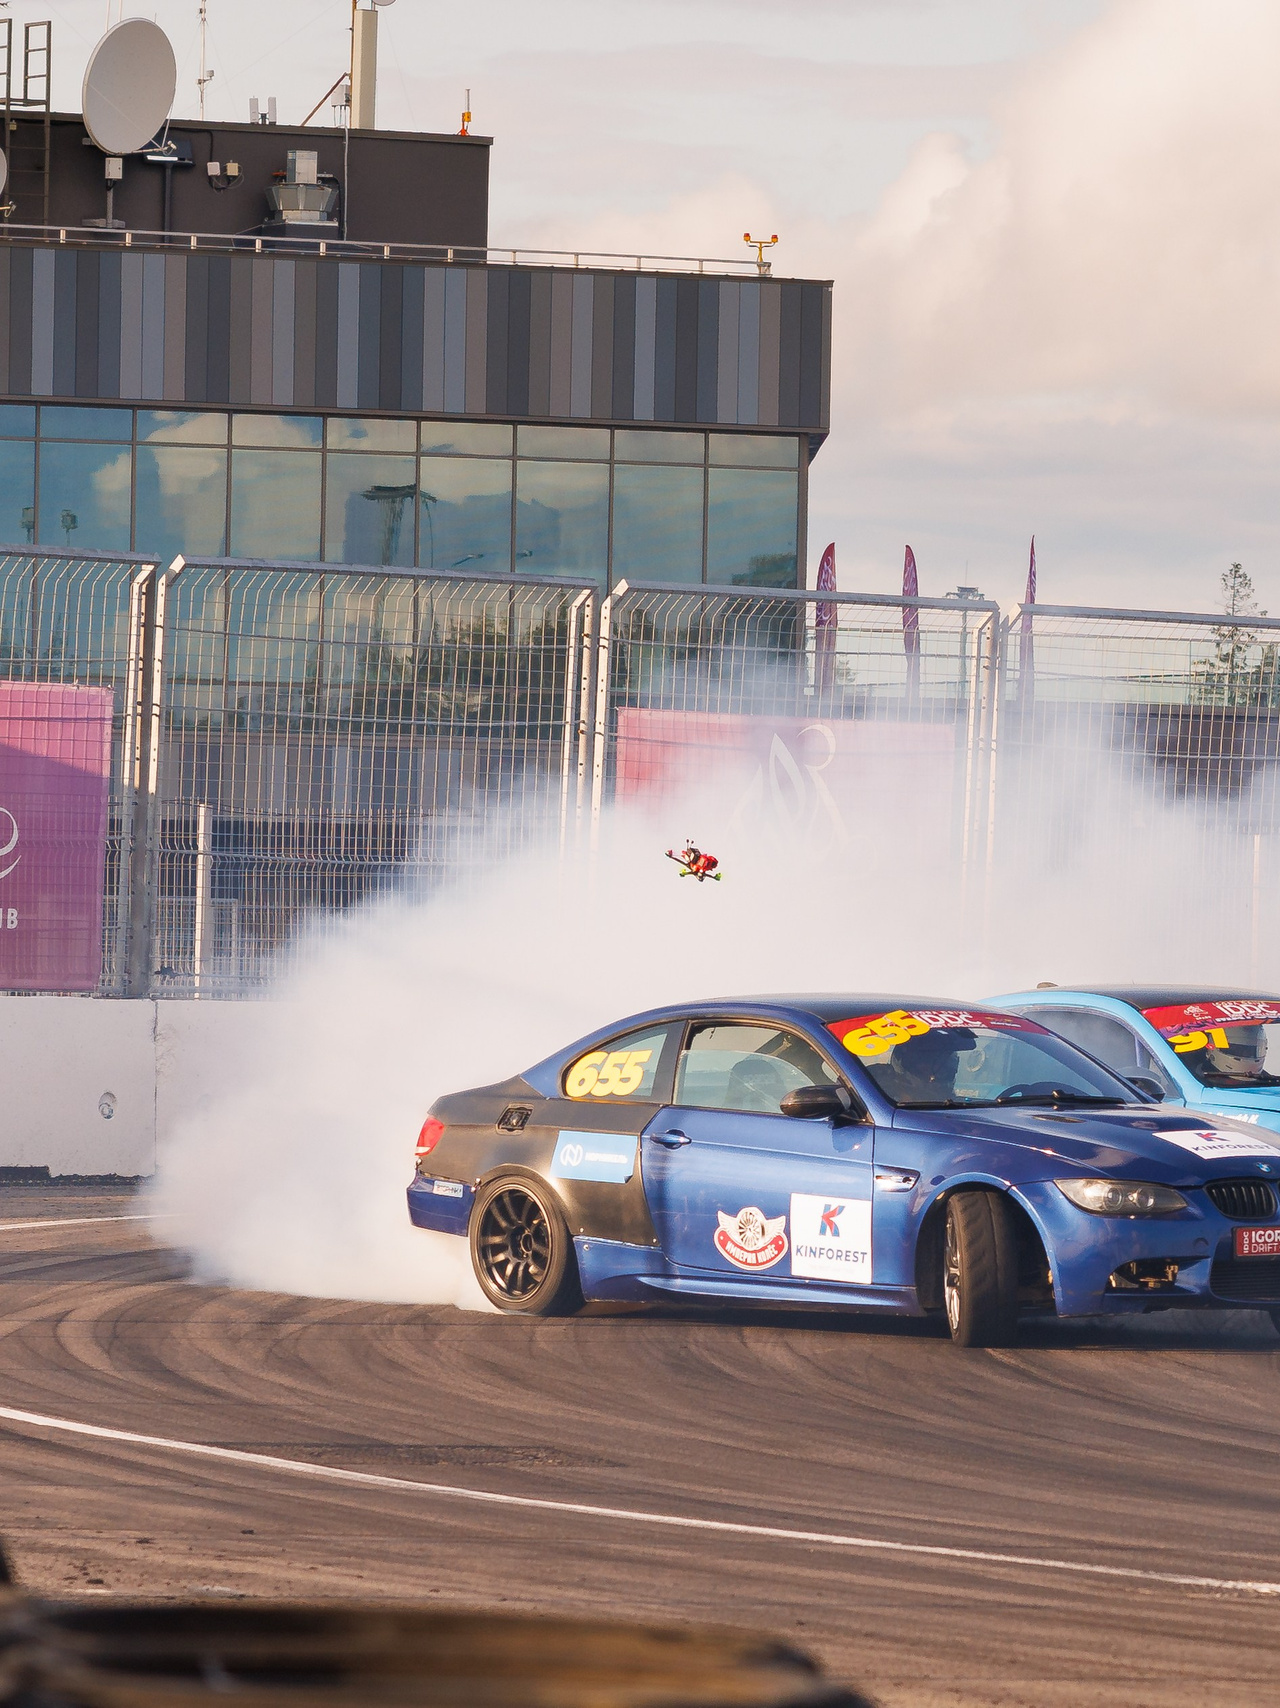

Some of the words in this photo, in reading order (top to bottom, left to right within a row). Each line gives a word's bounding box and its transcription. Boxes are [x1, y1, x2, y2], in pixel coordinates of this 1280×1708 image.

[842, 1009, 931, 1057] 655
[1167, 1027, 1231, 1054] 91
[565, 1049, 653, 1098] 655
[1191, 1143, 1272, 1153] KINFOREST
[795, 1244, 868, 1264] KINFOREST
[1251, 1242, 1278, 1253] DRIFT
